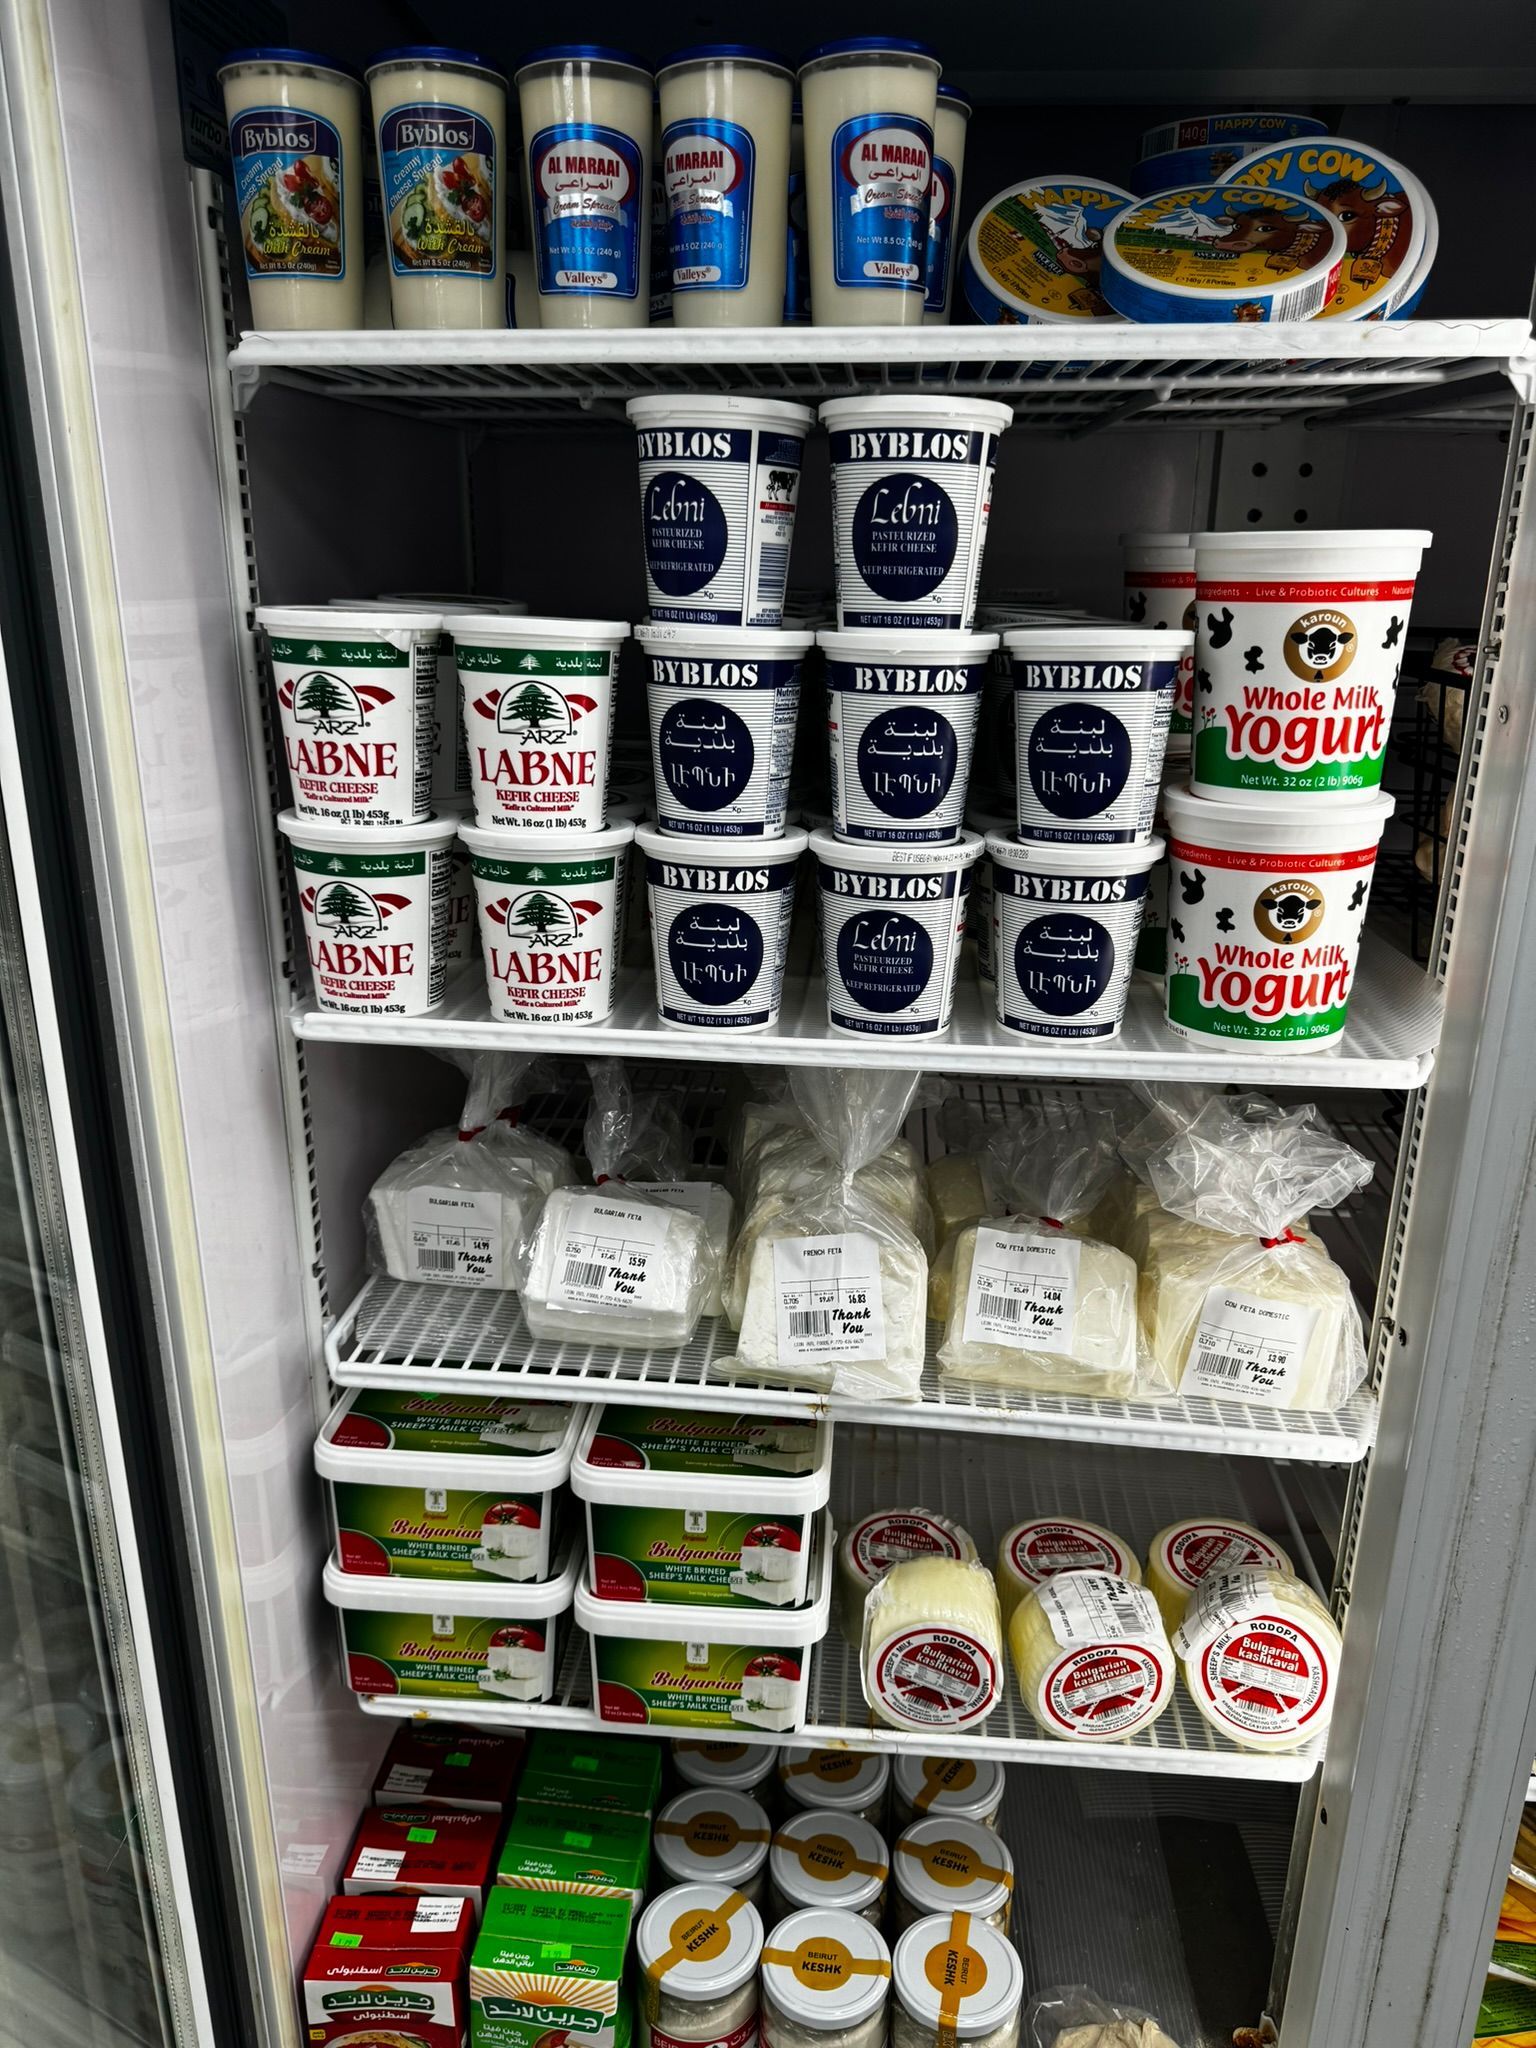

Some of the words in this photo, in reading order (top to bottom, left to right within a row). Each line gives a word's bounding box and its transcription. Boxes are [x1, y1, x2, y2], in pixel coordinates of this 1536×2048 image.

[244, 127, 310, 152] Byblos
[401, 123, 470, 148] Byblos
[1181, 123, 1208, 142] 140g
[1214, 119, 1257, 131] HAPPY
[676, 151, 724, 171] MARAAI
[861, 143, 878, 163] AL
[881, 145, 926, 169] MARAAI
[1298, 151, 1375, 181] COW
[393, 155, 421, 186] Creamy
[411, 153, 443, 182] Spread
[548, 157, 563, 174] AL
[565, 156, 620, 178] MARAAI
[582, 198, 616, 213] Spread
[864, 189, 894, 204] Cream
[1017, 188, 1125, 211] HAPPY
[1123, 190, 1216, 231] HAPPY
[1222, 190, 1299, 211] COW
[291, 241, 331, 258] Cream
[416, 238, 444, 252] With
[871, 236, 882, 245] Wt
[637, 431, 732, 460] BYBLOS
[850, 433, 969, 460] BYBLOS
[651, 480, 706, 523] Lebni
[871, 481, 941, 525] Lebni
[872, 531, 936, 542] PASTEURIZED
[880, 566, 944, 576] REFRIGERATED
[1256, 588, 1277, 599] Live
[1279, 588, 1287, 599] &
[1289, 588, 1339, 600] Probiotic
[1341, 588, 1380, 600] Cultures
[1300, 614, 1348, 630] karoun
[652, 659, 759, 687] BYBLOS
[855, 667, 969, 693] BYBLOS
[1026, 664, 1142, 690] BYBLOS
[1243, 686, 1326, 710] Whole
[1333, 684, 1381, 710] Milk
[676, 714, 727, 737] لبنة
[884, 721, 938, 742] لبنة
[1050, 718, 1106, 739] لبنة
[1225, 704, 1388, 766] Yogurt
[520, 732, 567, 746] ARZ
[664, 732, 737, 753] بلدية
[1036, 737, 1113, 759] بلدية
[285, 737, 399, 779] LABNE
[867, 739, 944, 761] بلدية
[477, 747, 597, 786] LABNE
[330, 782, 379, 795] CHEESE
[1241, 774, 1259, 785] Net
[1261, 775, 1280, 786] Wt.
[1283, 776, 1297, 787] 32
[1299, 778, 1313, 788] oz
[1314, 777, 1325, 788] (2
[1342, 775, 1363, 787] 906g
[496, 789, 532, 803] KEFIR
[534, 791, 580, 803] CHEESE
[367, 811, 390, 822] 453g
[522, 816, 534, 827] 16
[557, 817, 569, 829] lb)
[569, 814, 588, 829] 453g
[1094, 831, 1116, 842] (453g)
[1227, 855, 1248, 866] Live
[1249, 857, 1257, 868] &
[1260, 858, 1306, 869] Probiotic
[1308, 858, 1345, 868] Cultures
[662, 865, 769, 892] BYBLOS
[834, 873, 943, 899] BYBLOS
[1014, 873, 1128, 902] BYBLOS
[1269, 881, 1316, 897] karoun
[333, 924, 378, 939] ARZ
[690, 916, 740, 936] لبنة
[852, 917, 917, 952] Lebni
[1039, 926, 1093, 946] لبنة
[676, 931, 748, 953] بلدية
[854, 953, 913, 966] PASTEURIZED
[1023, 944, 1100, 963] بلدية
[1215, 942, 1294, 969] Whole
[1301, 944, 1345, 969] Milk
[489, 947, 603, 985] LABNE
[506, 986, 540, 1001] KEFIR
[542, 987, 587, 1000] CHEESE
[863, 982, 921, 993] REFRIGERATED
[1197, 957, 1351, 1017] Yogurt
[384, 1003, 406, 1014] 453g
[531, 1010, 542, 1021] 16
[564, 1010, 575, 1023] lb)
[1050, 1025, 1060, 1034] OZ
[1080, 1025, 1099, 1035] (453g)
[1213, 1021, 1230, 1033] Net
[1231, 1024, 1250, 1036] Wt.
[1254, 1026, 1268, 1037] 32
[1269, 1028, 1283, 1037] oz
[1311, 1023, 1332, 1035] 906g
[594, 1207, 625, 1220] BULGARIAN
[627, 1213, 642, 1222] FETA
[803, 1248, 825, 1257] FRENCH
[1026, 1246, 1056, 1255] DOMESTIC
[608, 1267, 647, 1282] Thank
[614, 1280, 635, 1294] You
[832, 1307, 871, 1321] Thank
[1024, 1301, 1064, 1315] Thank
[1240, 1304, 1256, 1314] FETA
[1258, 1309, 1290, 1321] DOMESTIC
[842, 1322, 864, 1334] You
[1032, 1314, 1054, 1327] You
[402, 1399, 520, 1418] Bulgarian
[389, 1519, 484, 1541] Bulgarian
[392, 1547, 426, 1557] SHEEP'S
[427, 1550, 450, 1559] MILK
[407, 1541, 434, 1552] WHITE
[436, 1543, 468, 1553] BRINED
[647, 1541, 744, 1563] Bulgarian
[649, 1571, 685, 1582] SHEEP'S
[665, 1565, 693, 1576] WHITE
[694, 1567, 727, 1577] BRINED
[398, 1642, 490, 1662] Bulgarian
[932, 1635, 978, 1658] RODOPA
[1241, 1636, 1300, 1662] Bulgarian
[922, 1645, 974, 1674] Bulgarian
[1072, 1648, 1119, 1666] RODOPA
[1217, 1632, 1233, 1651] MILK
[1249, 1622, 1298, 1642] RODOPA
[1302, 1665, 1320, 1705] KASHKAVAL
[1238, 1645, 1300, 1674] kashkaval
[916, 1653, 973, 1683] kashkaval
[1072, 1660, 1127, 1680] Bulgarian
[1073, 1666, 1130, 1689] kashkaval
[650, 1671, 744, 1691] Bulgarian
[808, 1852, 845, 1871] KESHK
[932, 1856, 969, 1875] KESHK
[681, 1919, 705, 1942] BEIRUT
[686, 1923, 720, 1953] KESHK
[808, 1951, 838, 1962] BEIRUT
[802, 1961, 842, 1977] KESHK
[327, 1993, 371, 2008] لاند
[374, 1994, 432, 2010] جرين
[489, 2003, 534, 2020] لاند
[536, 2005, 598, 2031] جرين
